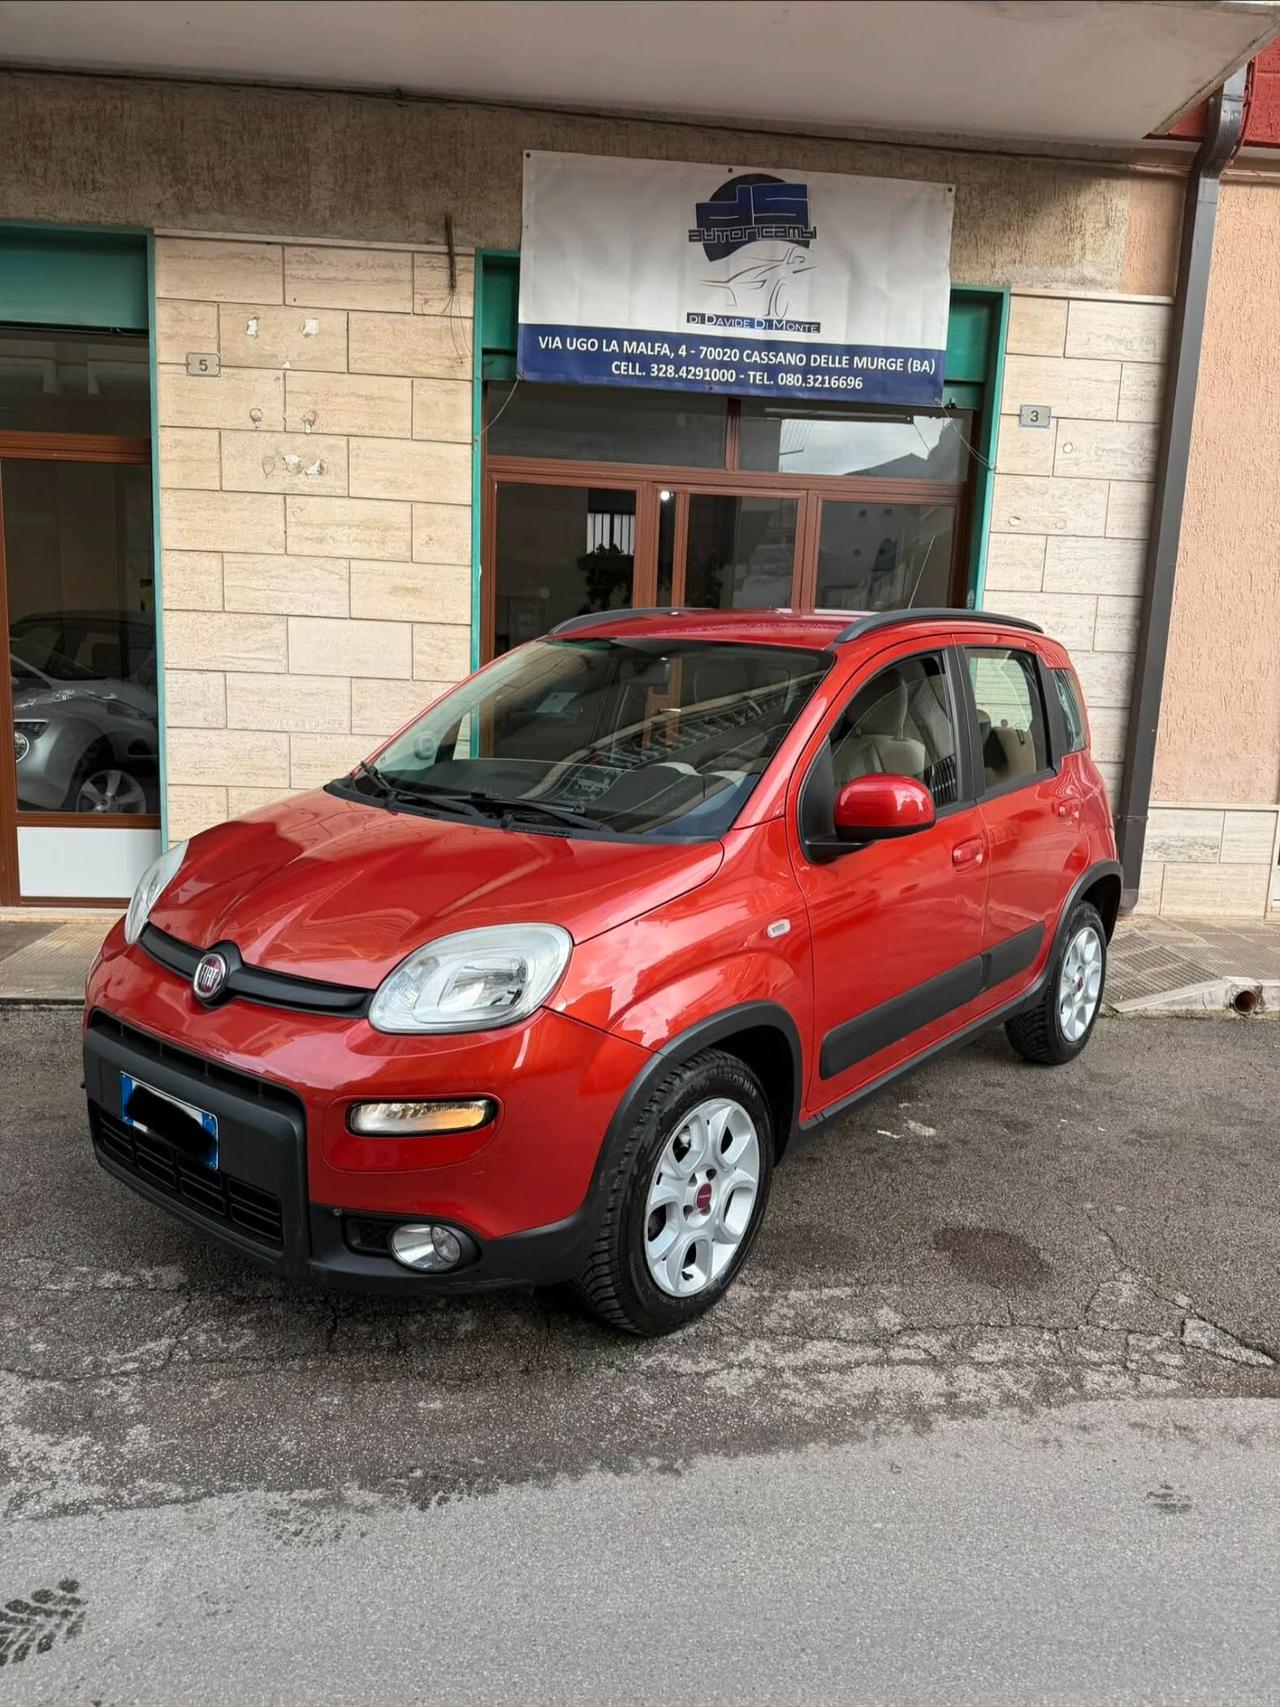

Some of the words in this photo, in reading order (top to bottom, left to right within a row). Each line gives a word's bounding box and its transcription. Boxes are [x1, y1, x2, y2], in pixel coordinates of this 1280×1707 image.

[199, 359, 208, 372] 5
[538, 336, 563, 350] VIA
[566, 337, 598, 351] UGO
[602, 339, 619, 353] LA
[623, 341, 675, 359] MALFA,
[678, 344, 687, 358] 4
[700, 346, 740, 362] 70020
[743, 350, 807, 366] CASSANO
[810, 354, 849, 368] DELLE
[853, 356, 904, 371] MURGE
[907, 357, 936, 375] (BA)
[611, 361, 646, 376] CELL.
[650, 363, 736, 382] 328.4291000
[748, 371, 774, 385] TEL.
[778, 373, 863, 390] 080.3216696
[1030, 410, 1039, 423] 3
[199, 964, 219, 987] FIAT
